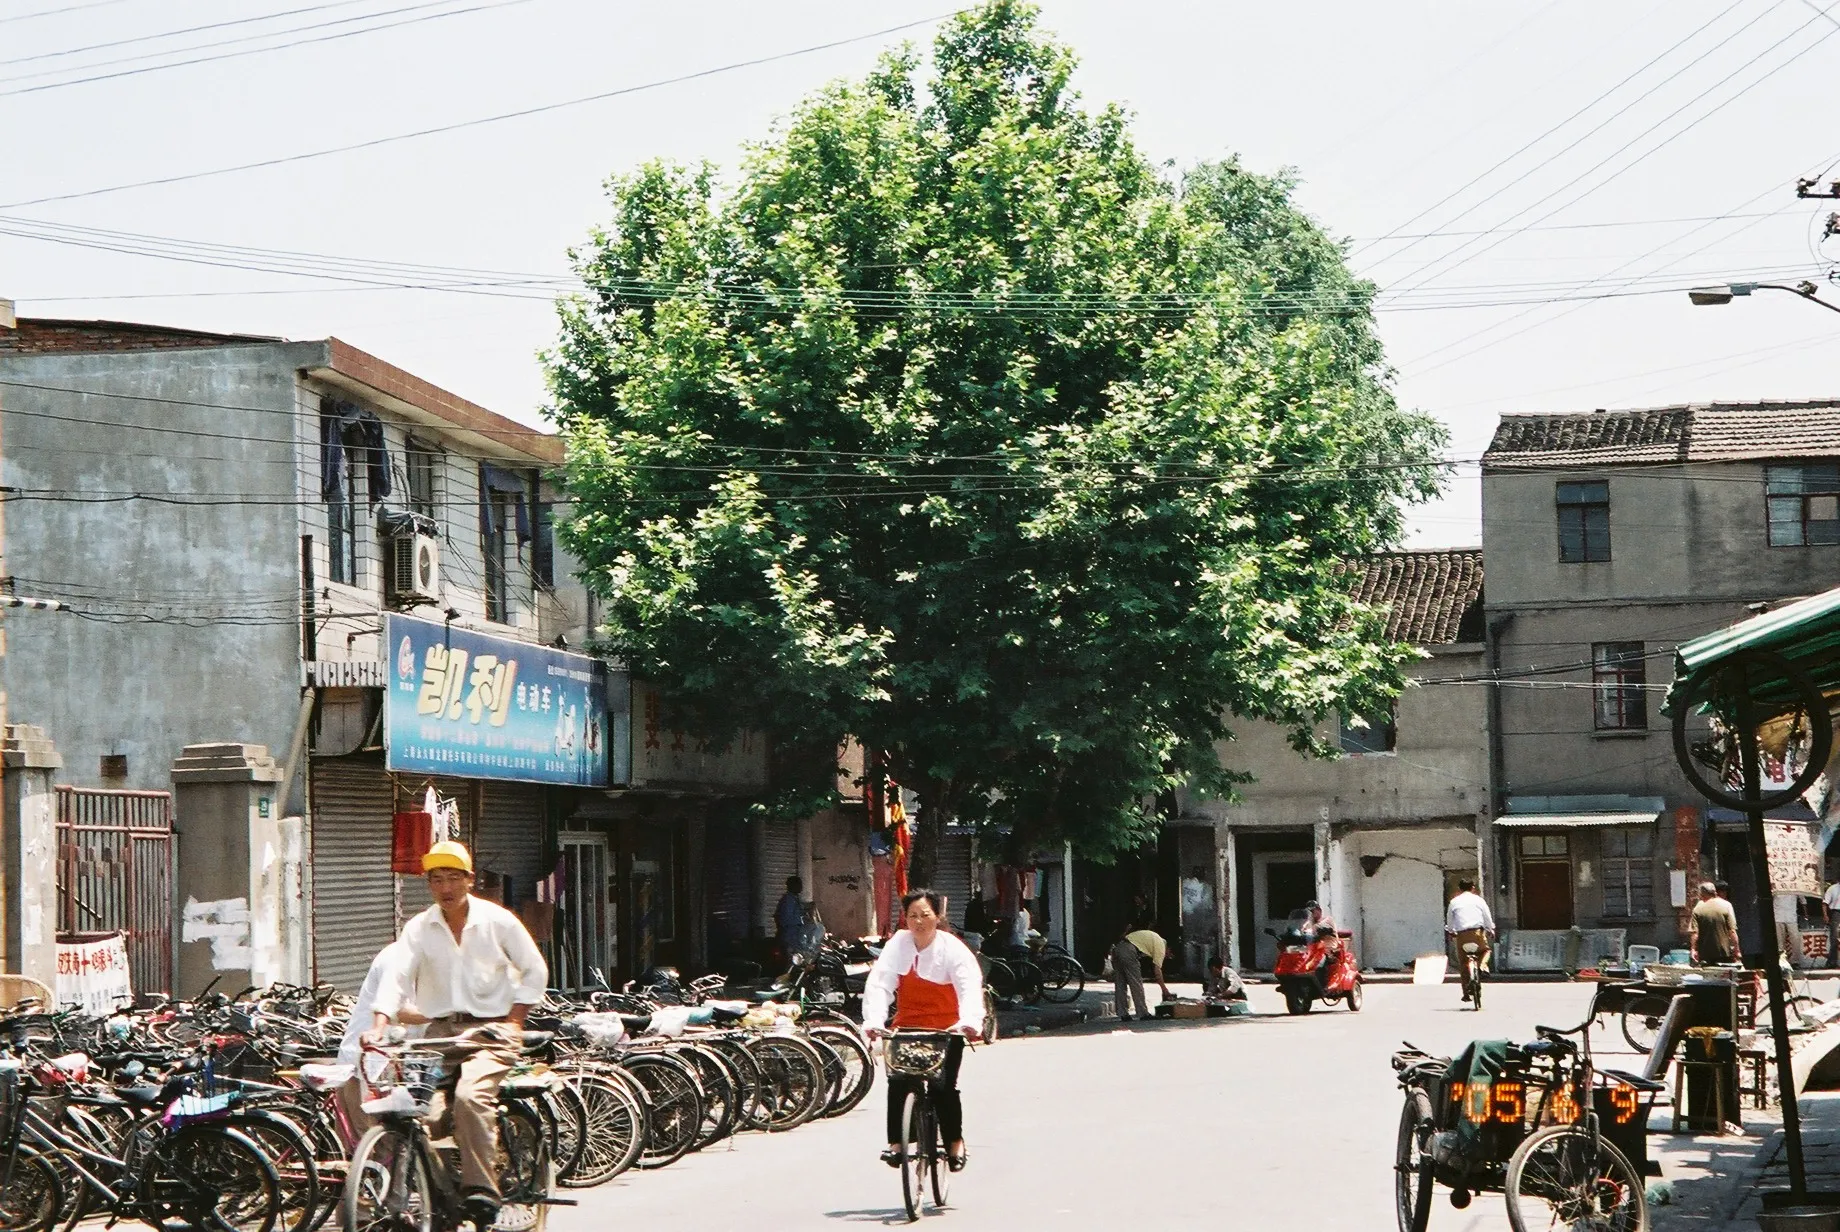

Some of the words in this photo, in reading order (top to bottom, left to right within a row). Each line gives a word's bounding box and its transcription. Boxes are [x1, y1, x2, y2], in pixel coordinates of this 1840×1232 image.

[417, 643, 517, 727] 凯利
[517, 681, 551, 714] 电动车
